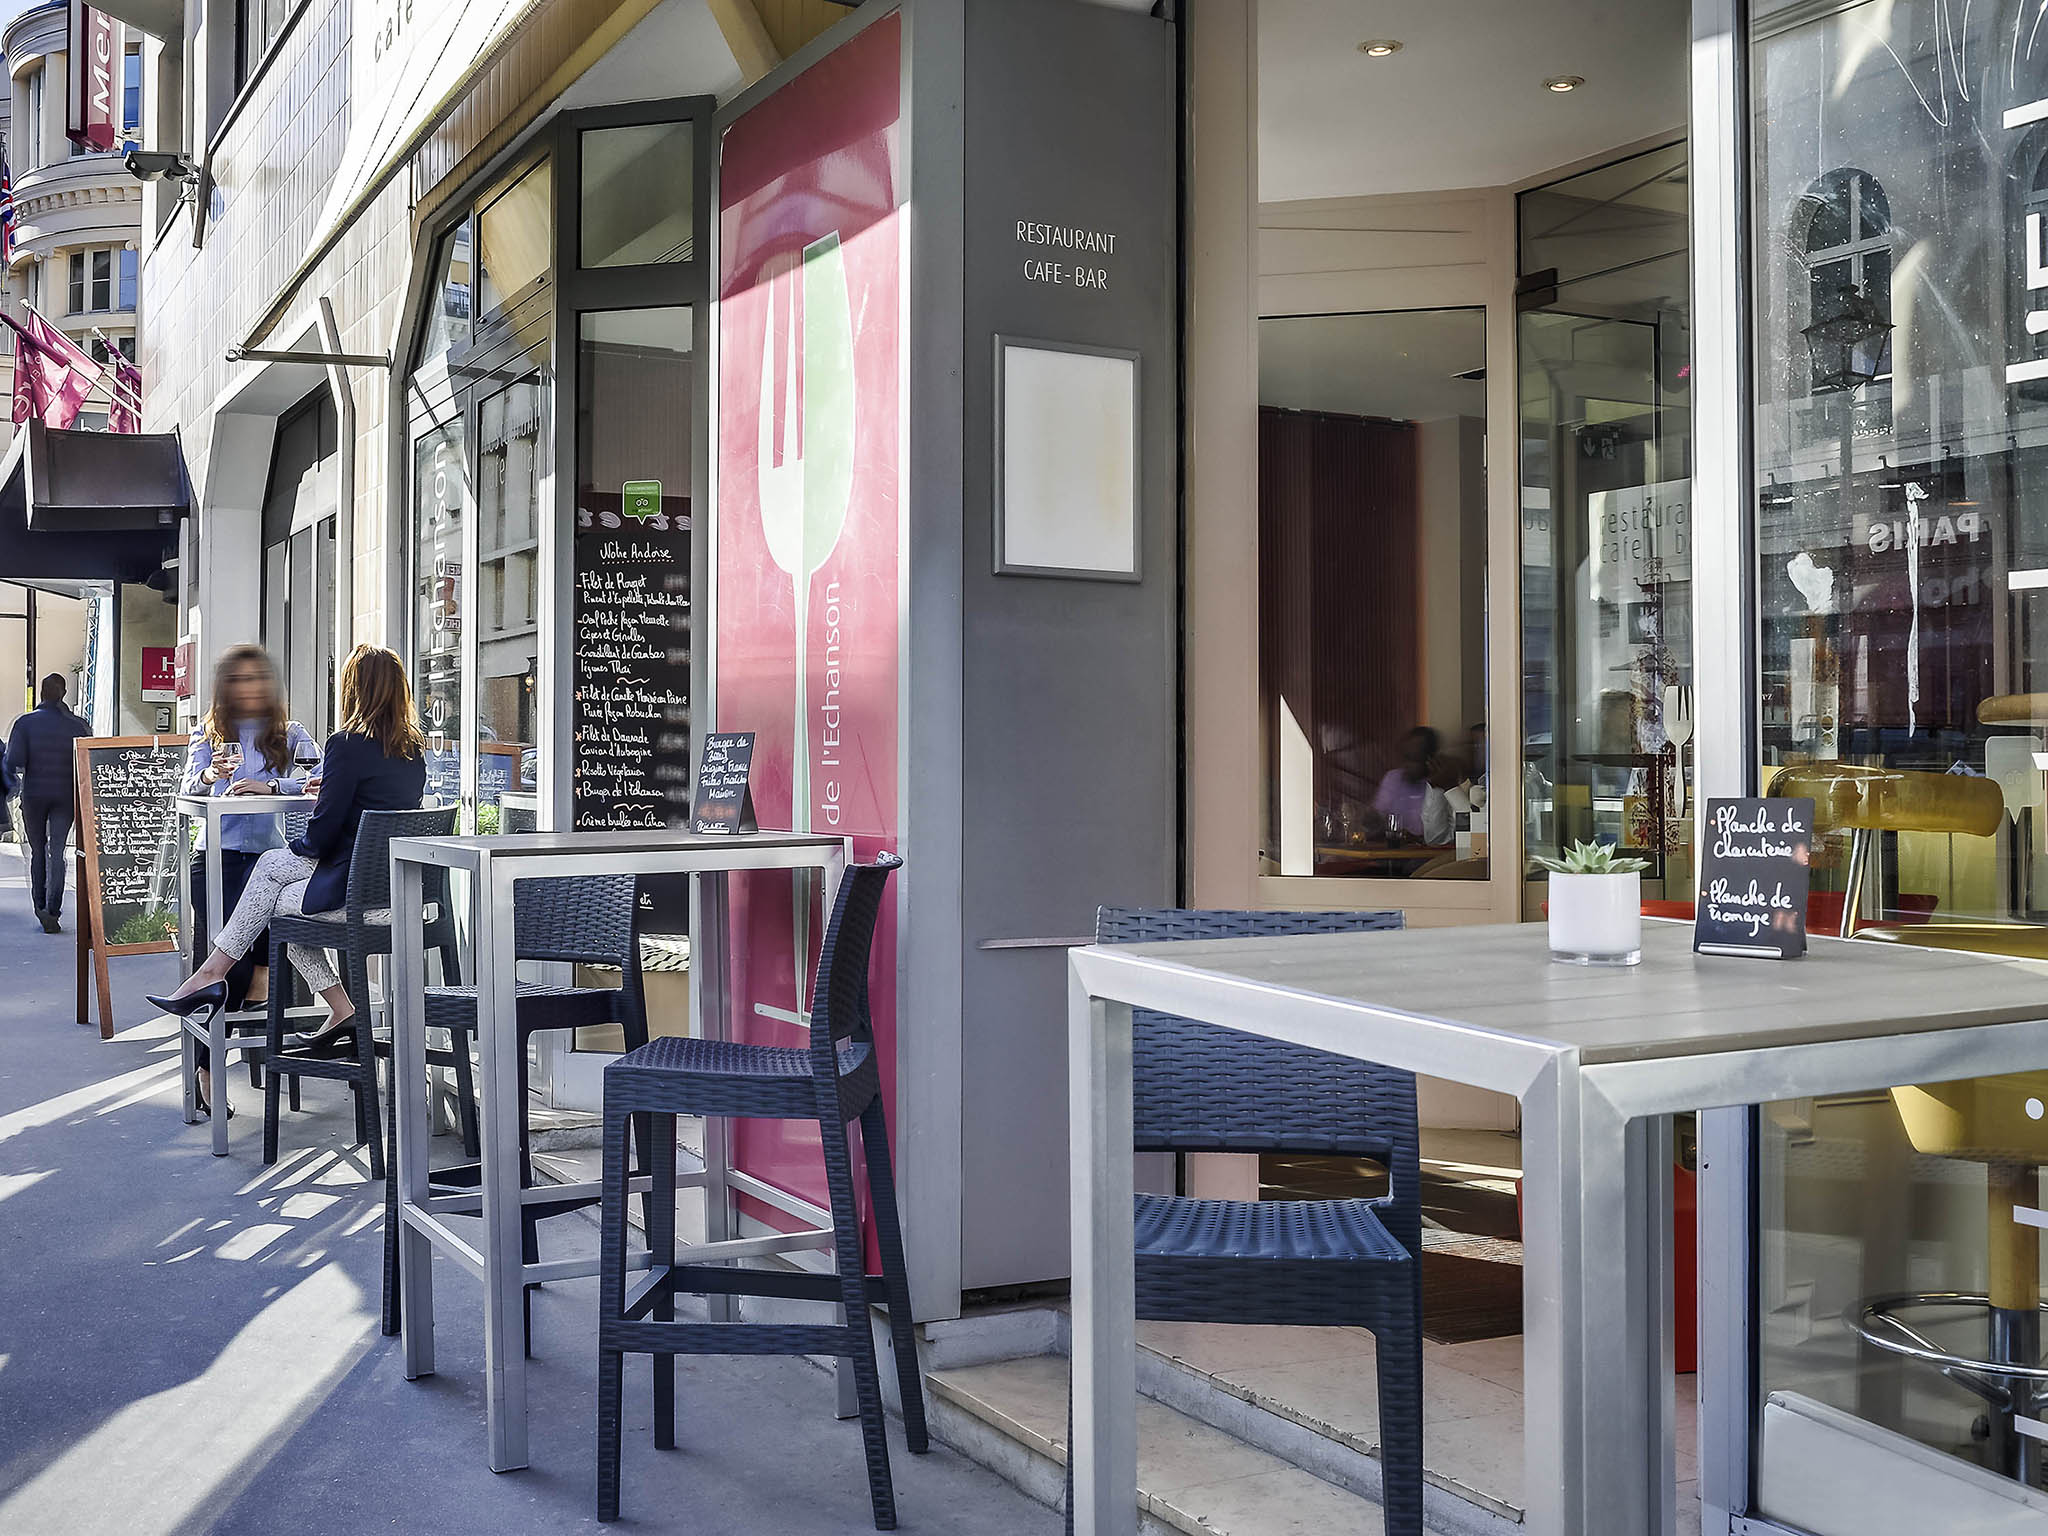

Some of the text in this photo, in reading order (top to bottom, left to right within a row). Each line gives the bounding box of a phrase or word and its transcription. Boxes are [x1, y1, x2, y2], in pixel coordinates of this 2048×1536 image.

[1016, 220, 1116, 254] RESTAURANT
[580, 570, 603, 590] Filet
[605, 572, 615, 589] de
[621, 644, 632, 659] de
[632, 644, 665, 659] Gambas
[580, 684, 601, 701] Filet
[600, 686, 610, 700] de
[821, 581, 841, 825] de l'Echanson
[428, 699, 446, 757] de
[581, 724, 600, 742] Filet
[600, 726, 611, 742] de
[736, 736, 749, 748] de
[581, 760, 607, 777] Risotto
[611, 782, 623, 797] de
[581, 811, 606, 826] Crème
[1716, 806, 1805, 834] Planche de
[1709, 878, 1793, 908] Planche de
